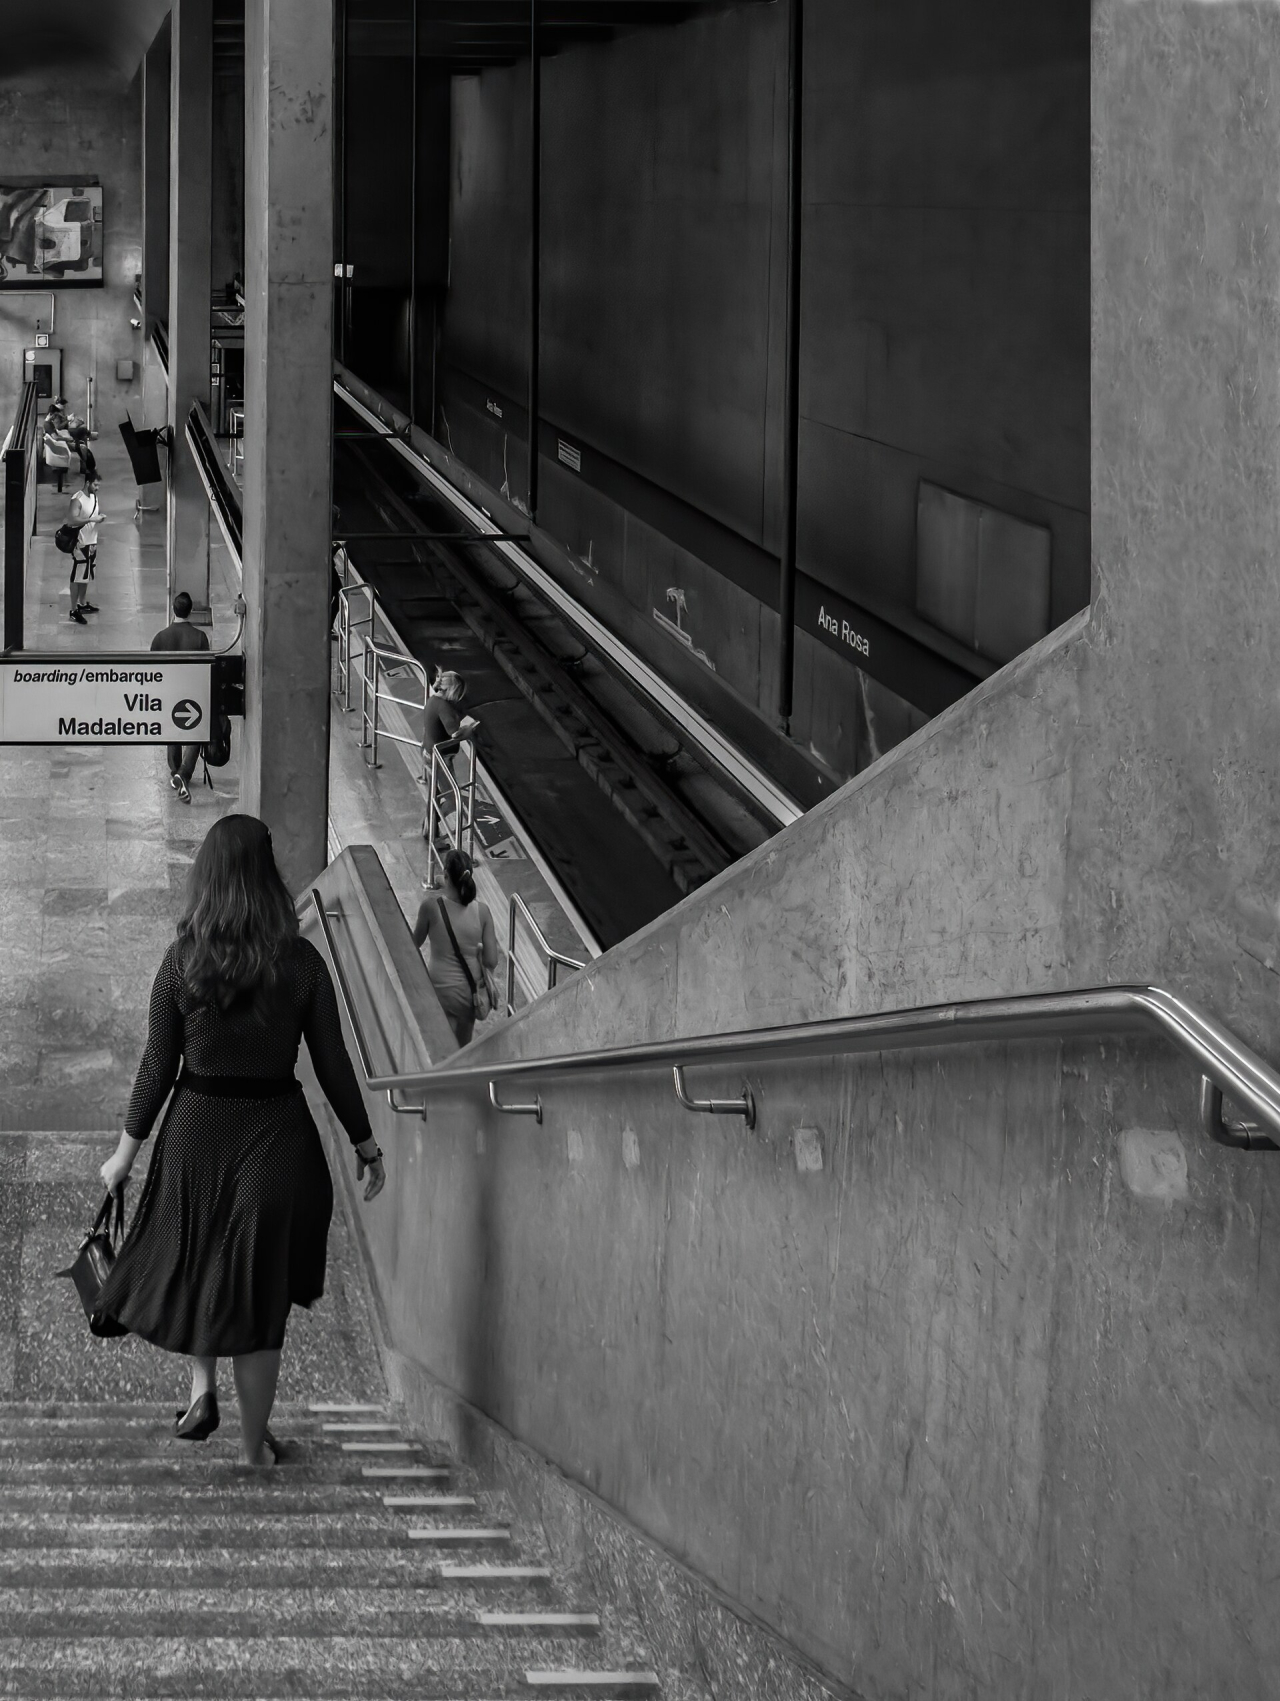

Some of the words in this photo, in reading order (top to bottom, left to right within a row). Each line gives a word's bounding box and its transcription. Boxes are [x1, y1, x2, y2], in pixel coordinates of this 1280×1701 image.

[817, 605, 839, 636] Ana
[841, 619, 870, 657] Rosa
[123, 693, 163, 712] Vila
[58, 717, 163, 736] Madalena
